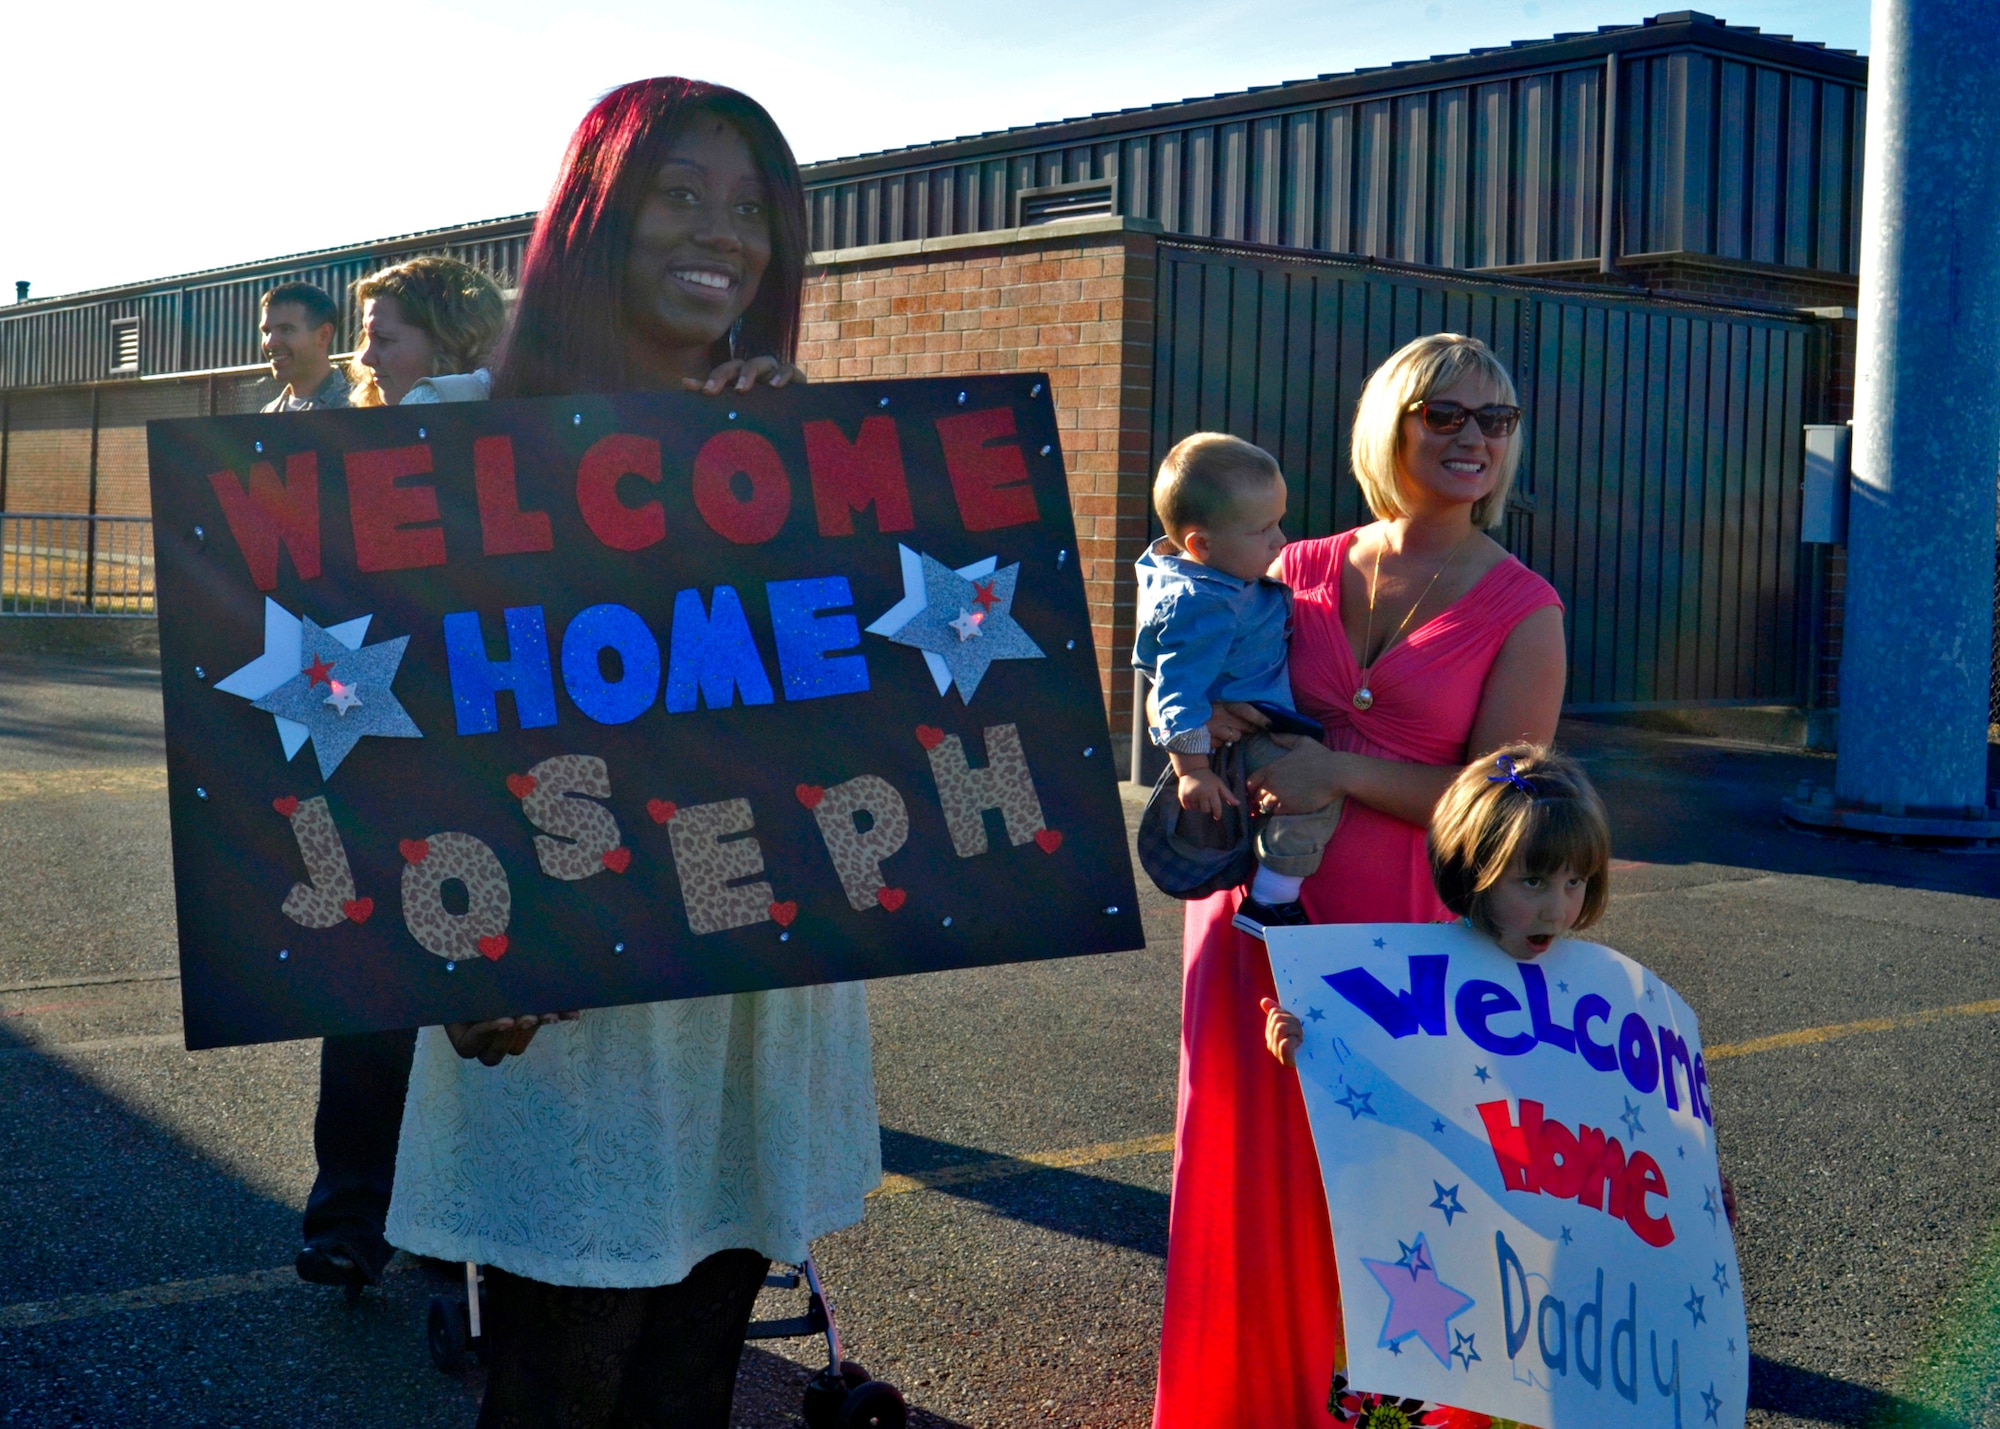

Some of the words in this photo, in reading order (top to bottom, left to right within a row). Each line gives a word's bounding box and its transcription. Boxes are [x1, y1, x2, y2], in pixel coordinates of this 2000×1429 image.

[209, 406, 1039, 590] WELCOME
[443, 576, 870, 736] HOME
[281, 722, 1050, 962] JOSEPH
[1476, 1098, 1675, 1248] Home
[1495, 1230, 1682, 1429] Daddy
